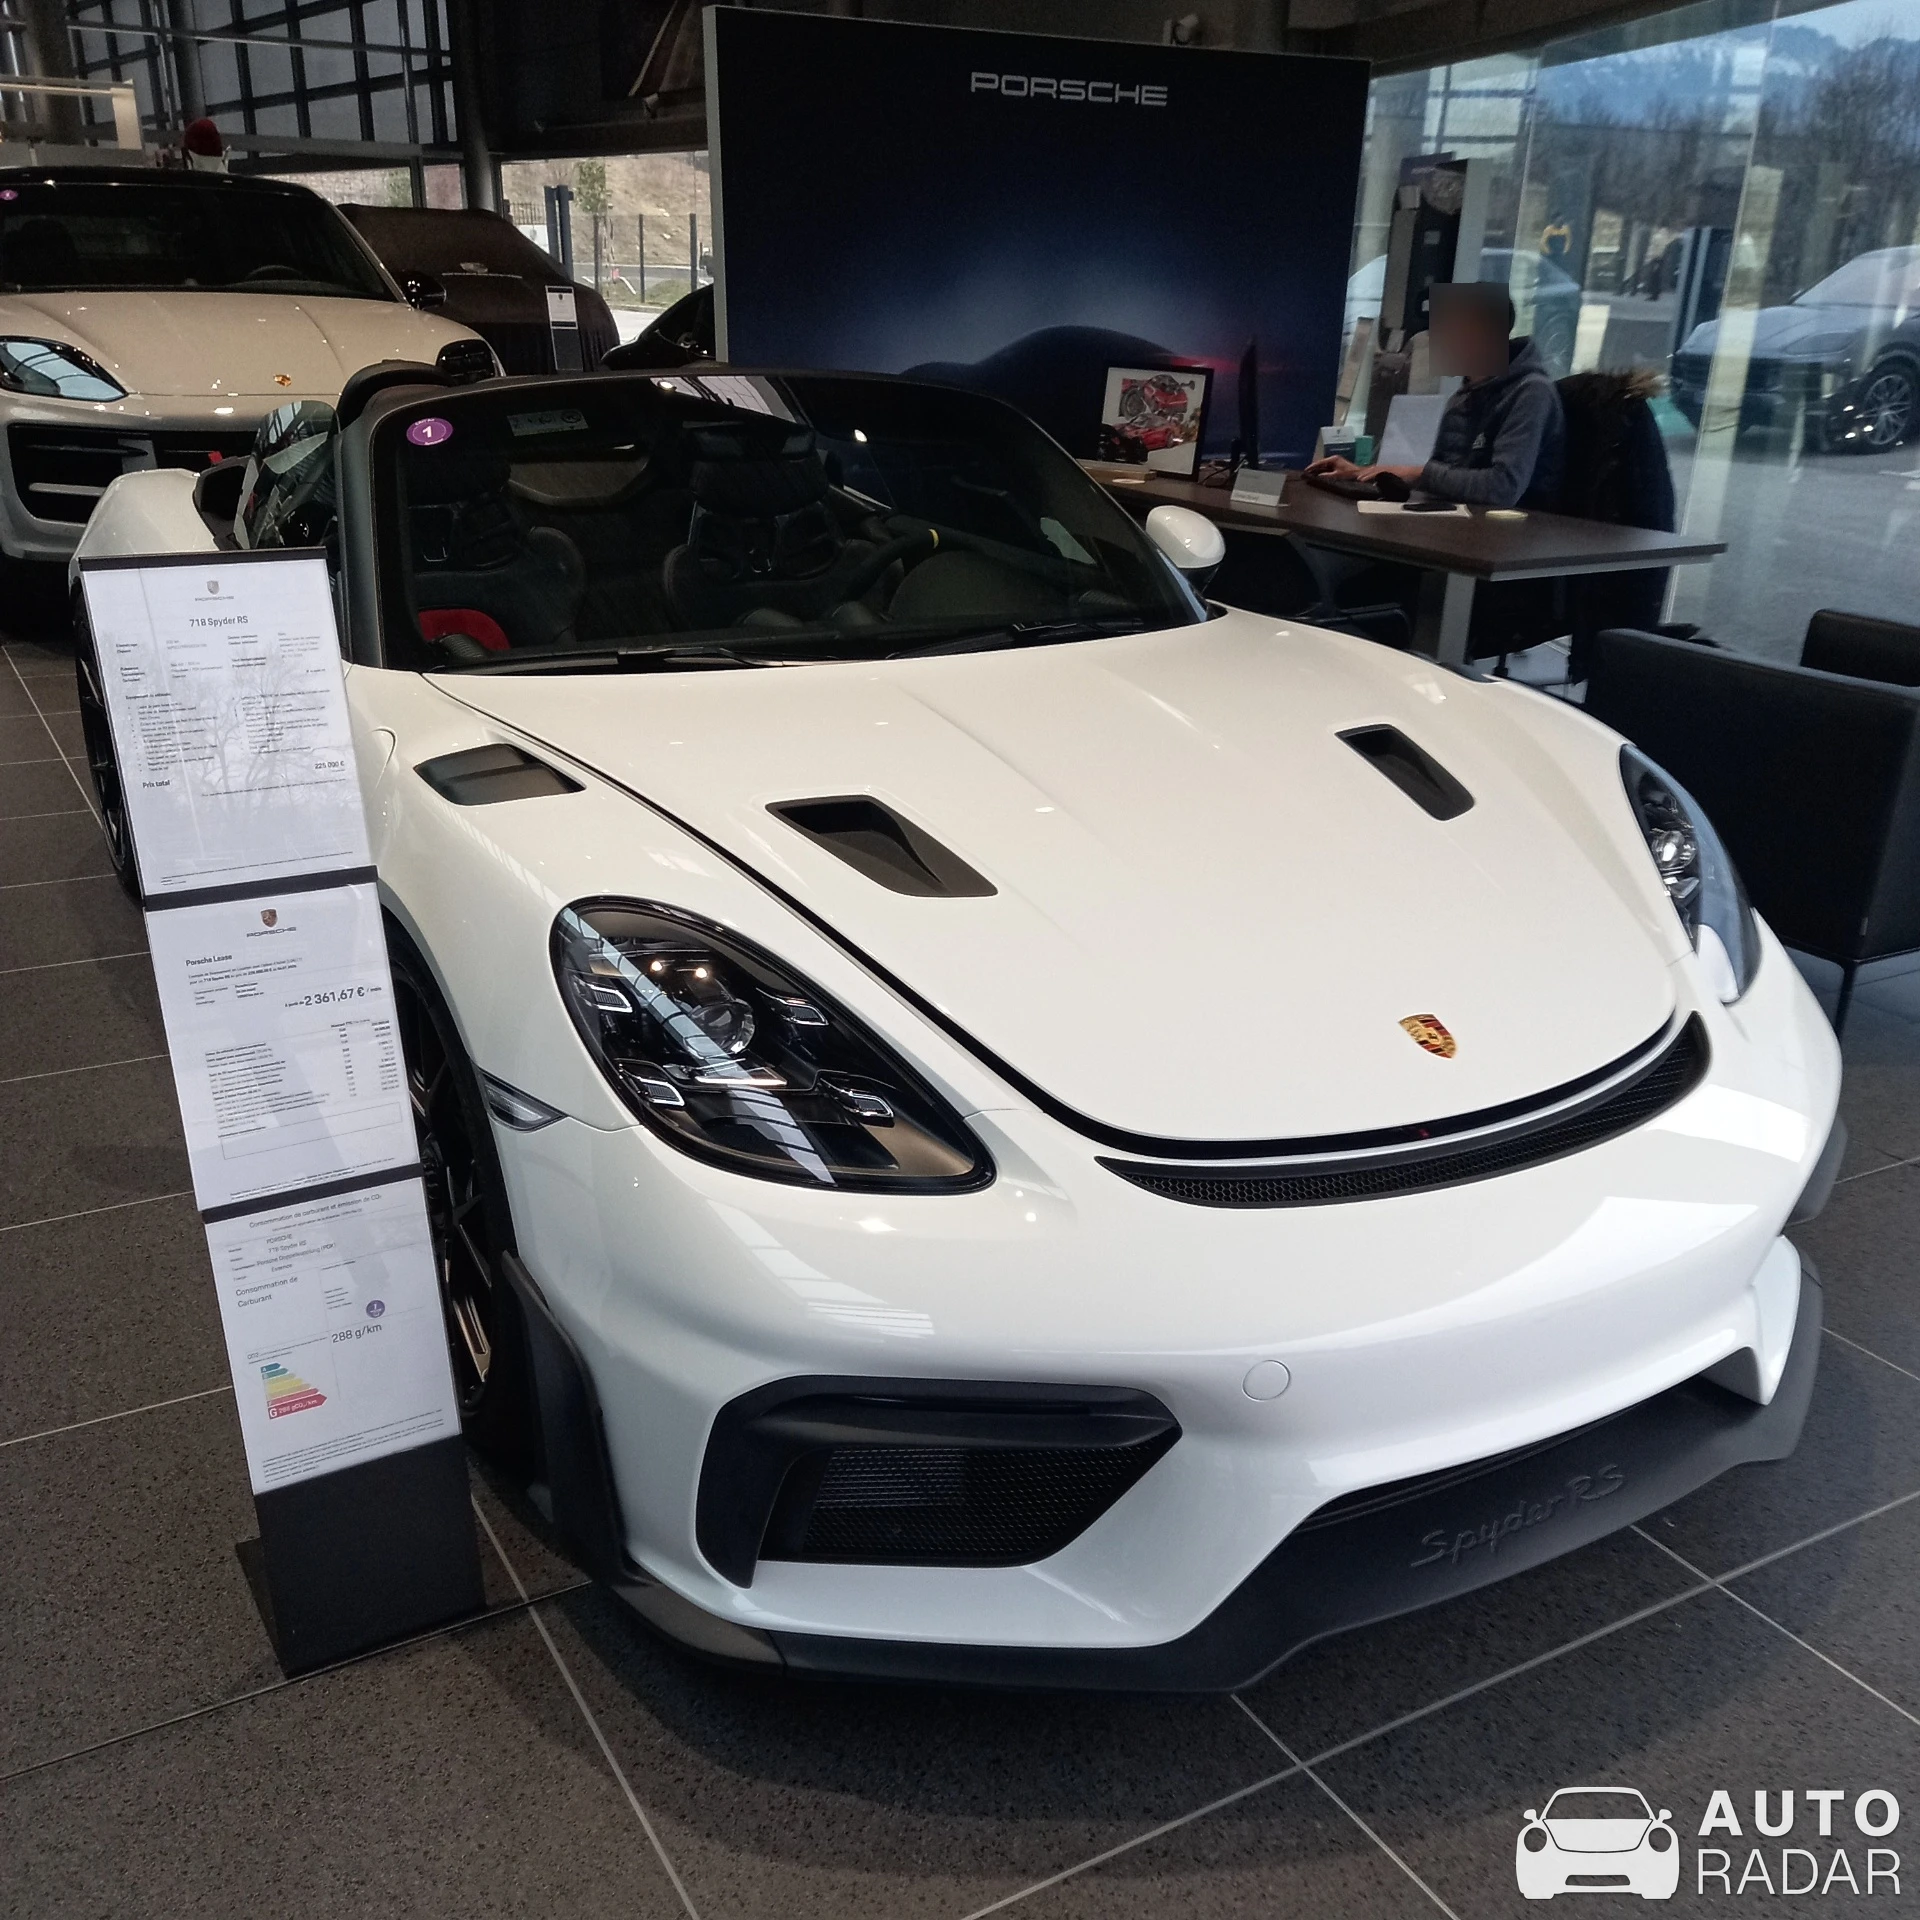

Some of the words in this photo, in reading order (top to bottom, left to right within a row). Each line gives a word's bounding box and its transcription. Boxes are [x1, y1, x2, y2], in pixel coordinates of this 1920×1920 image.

[971, 72, 1168, 107] PORSCHE
[422, 425, 432, 438] 1
[189, 618, 206, 627] 718
[207, 617, 235, 627] Spyder
[236, 615, 248, 624] RS
[246, 926, 297, 938] PORSCHE
[185, 956, 212, 967] Porsche
[212, 955, 233, 963] Lease
[313, 988, 354, 1005] 361,67
[357, 986, 365, 997] €
[249, 1213, 293, 1228] Consommation
[302, 1205, 329, 1217] carburant
[266, 1234, 292, 1245] PORSCHE
[235, 1278, 288, 1297] Consommation
[237, 1294, 272, 1308] Carburant
[331, 1329, 353, 1343] 288
[354, 1324, 382, 1339] g/km
[270, 1408, 278, 1418] G
[1410, 1496, 1565, 1568] Spyder
[1567, 1463, 1624, 1501] RS
